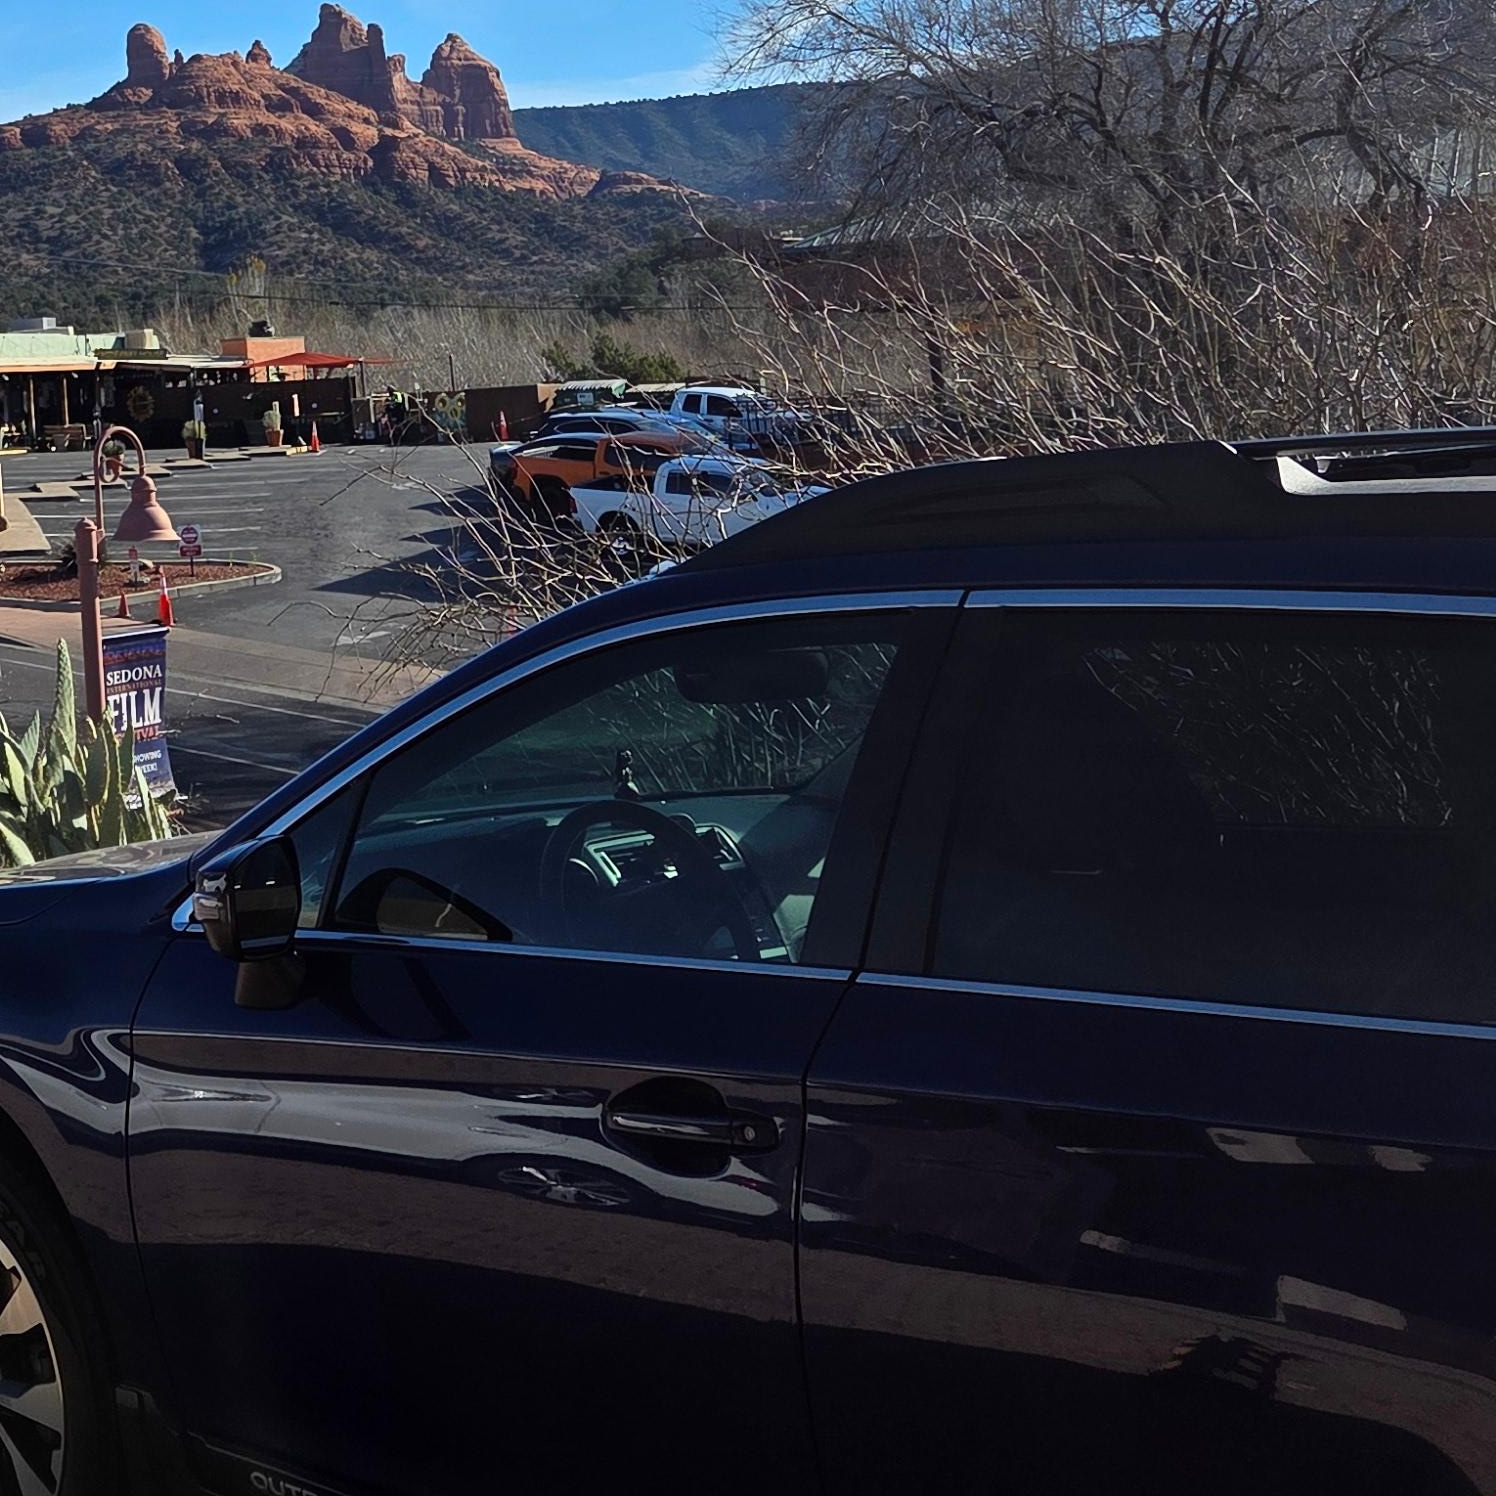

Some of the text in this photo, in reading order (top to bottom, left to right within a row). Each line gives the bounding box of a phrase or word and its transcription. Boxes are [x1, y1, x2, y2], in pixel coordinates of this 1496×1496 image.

[106, 664, 163, 686] SEDONA
[107, 686, 163, 734] FILM
[250, 1471, 317, 1496] OUT
